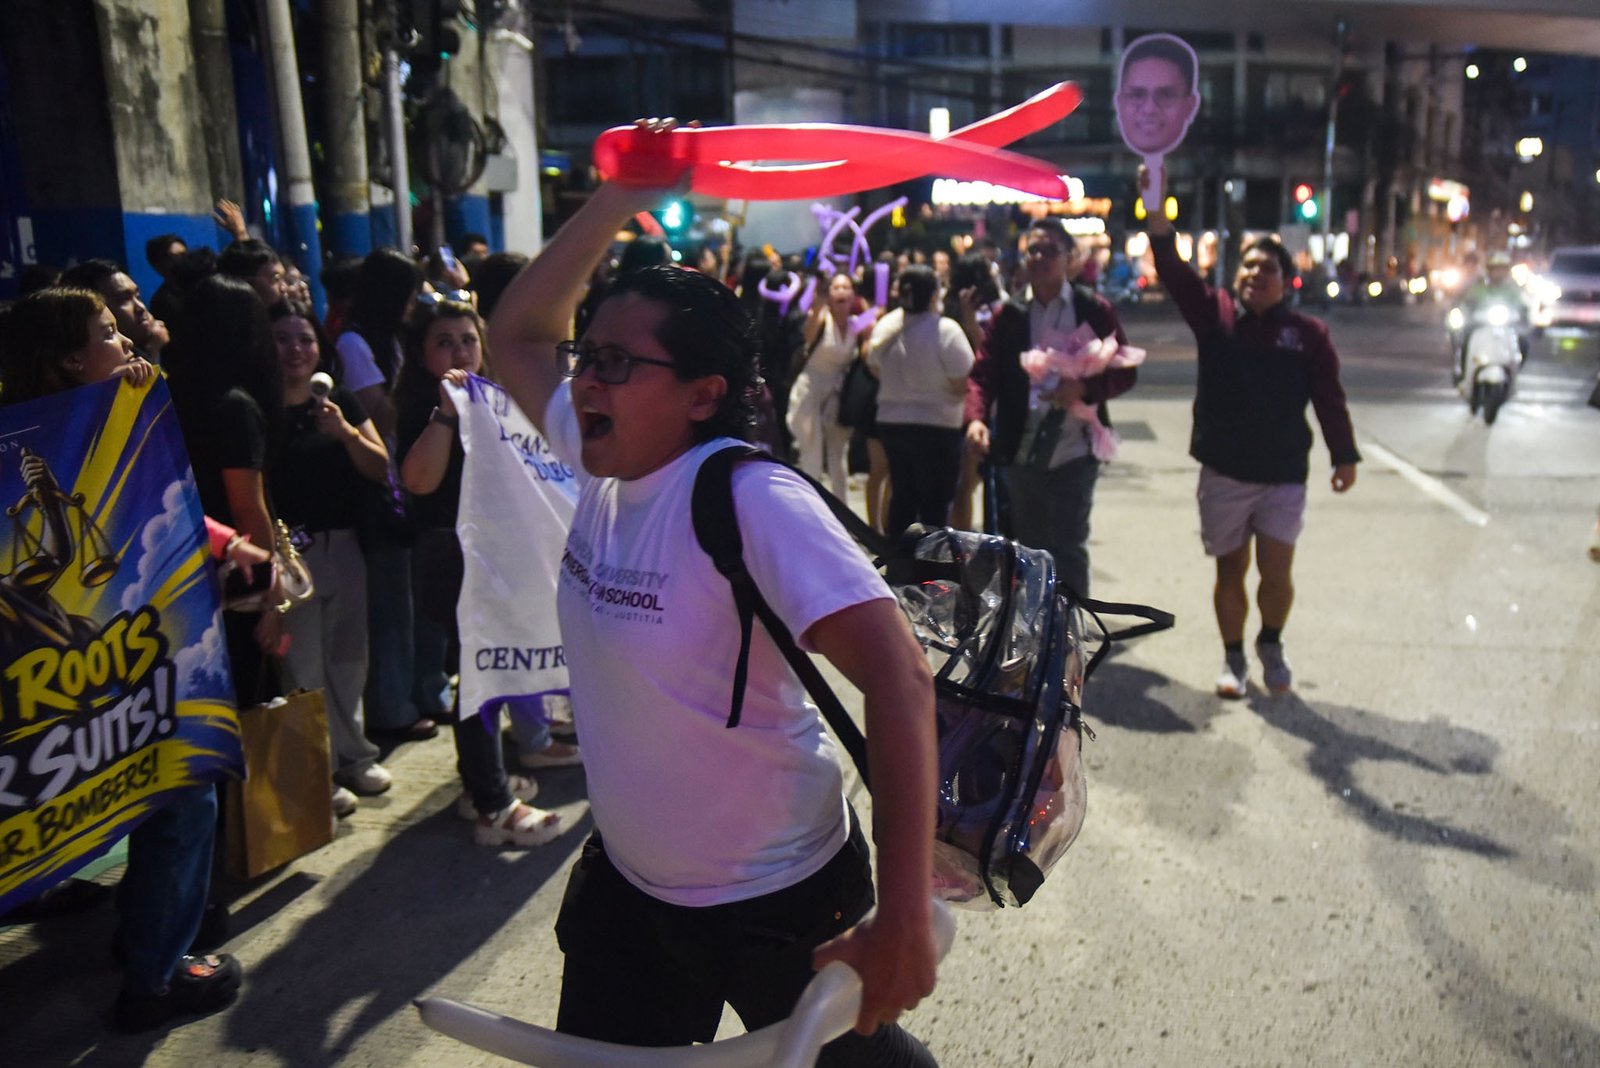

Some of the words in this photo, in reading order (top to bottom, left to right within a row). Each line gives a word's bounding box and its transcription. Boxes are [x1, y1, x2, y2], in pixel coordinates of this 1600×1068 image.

[605, 588, 665, 612] SCHOOL
[4, 611, 160, 720] ROOTS
[29, 667, 174, 801] SUITS!
[35, 751, 160, 850] BOMBERS!
